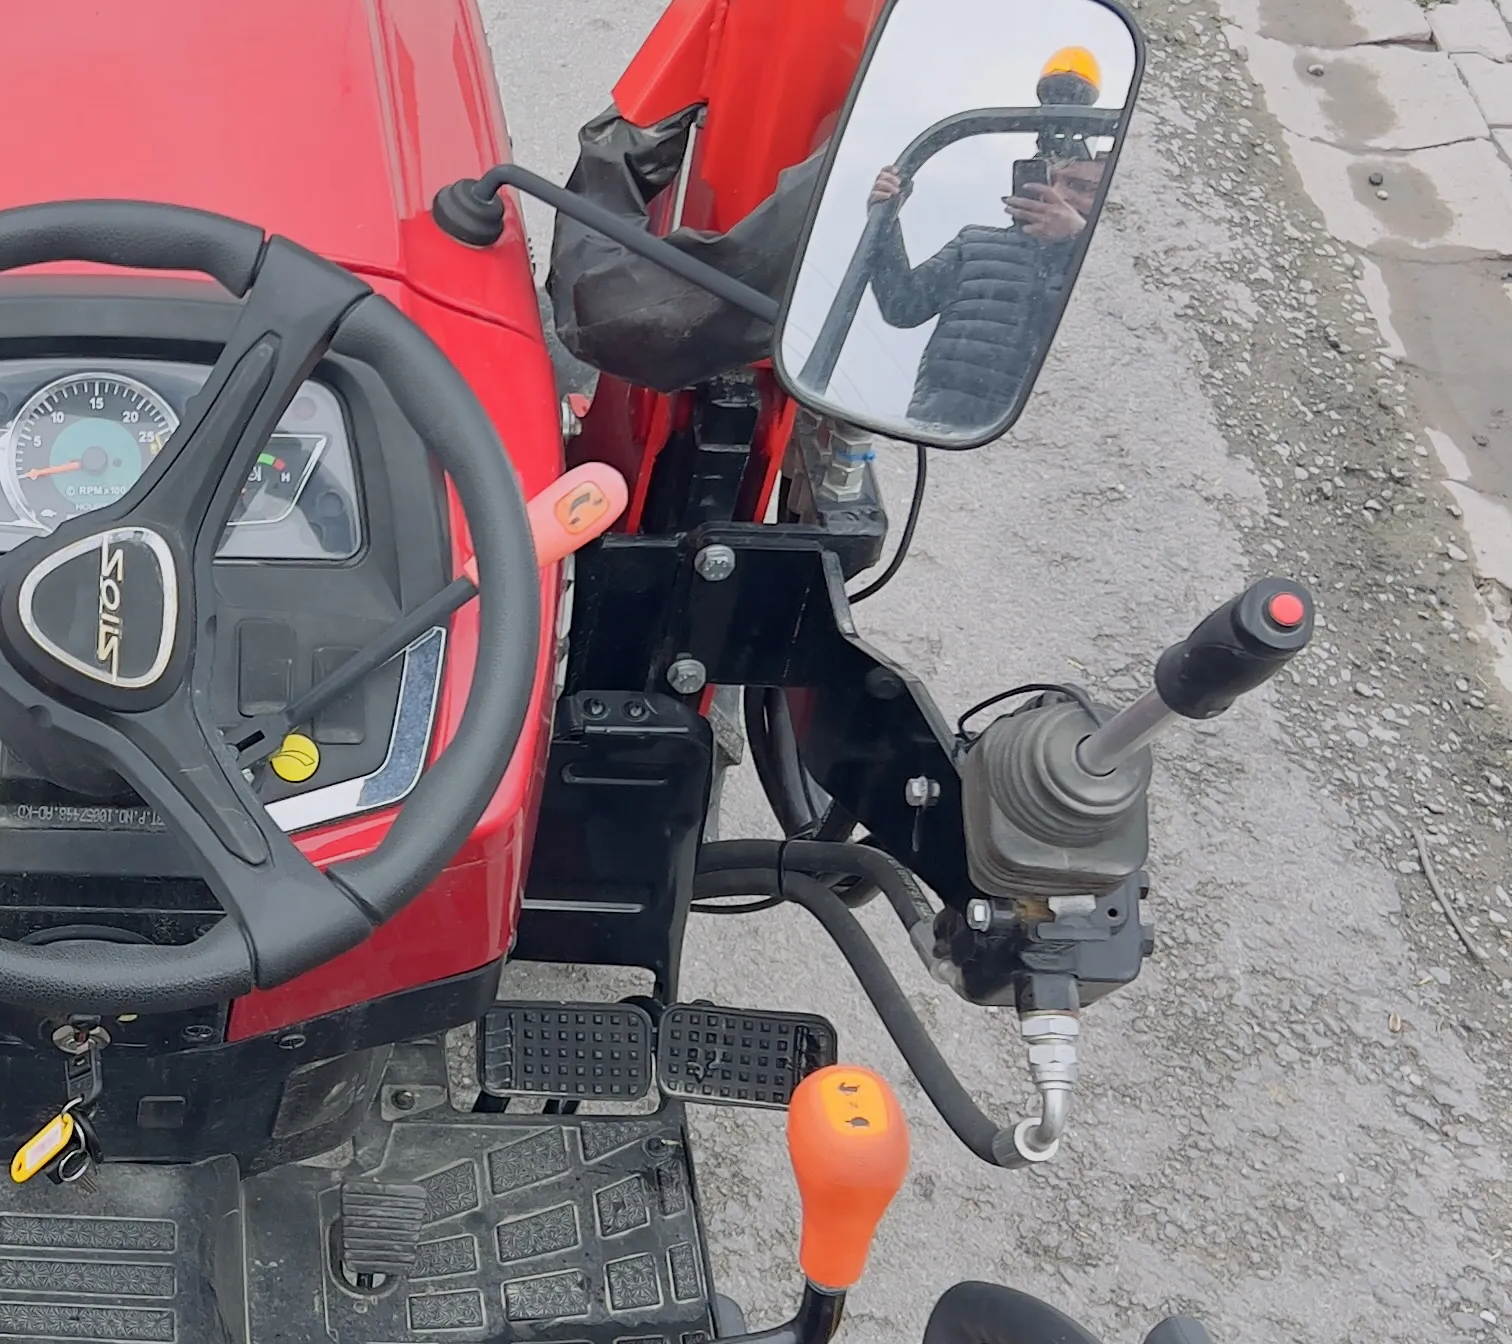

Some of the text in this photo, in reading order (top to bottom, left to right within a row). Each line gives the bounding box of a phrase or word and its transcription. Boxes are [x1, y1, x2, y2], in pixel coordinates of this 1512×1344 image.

[89, 397, 104, 409] 15
[50, 412, 65, 424] 10
[122, 411, 139, 424] 20
[33, 435, 42, 448] 5
[138, 431, 155, 443] 25
